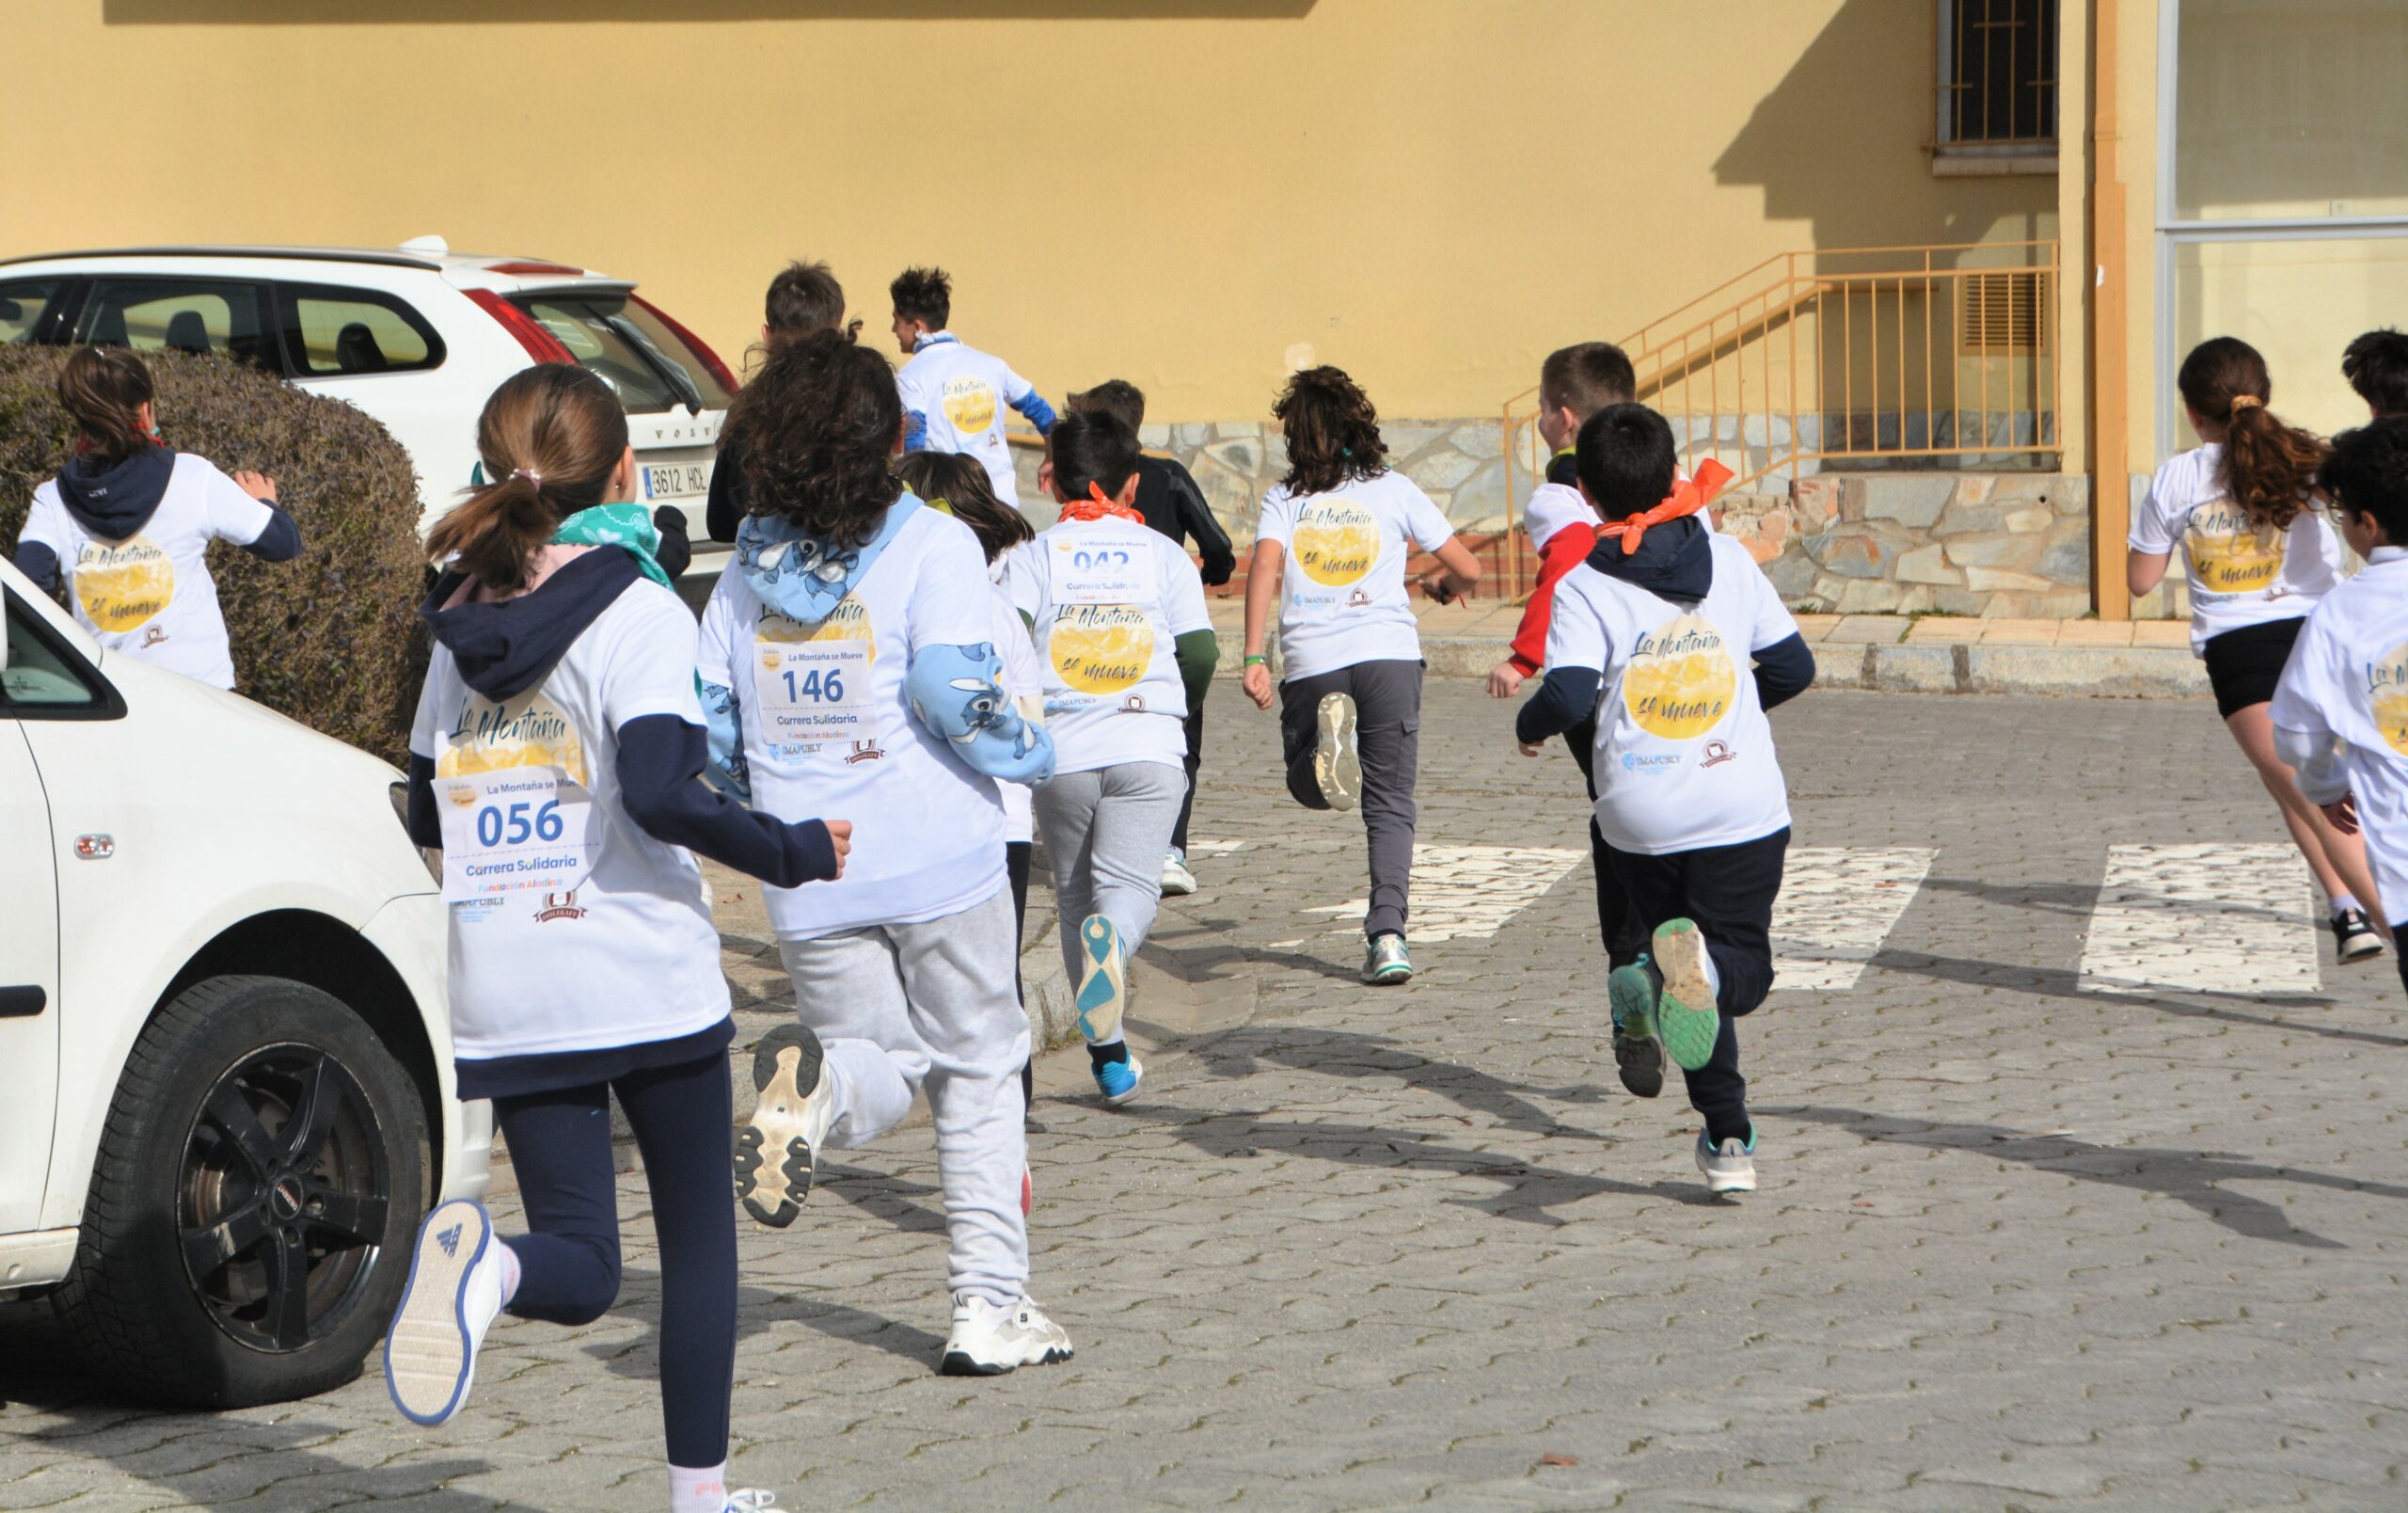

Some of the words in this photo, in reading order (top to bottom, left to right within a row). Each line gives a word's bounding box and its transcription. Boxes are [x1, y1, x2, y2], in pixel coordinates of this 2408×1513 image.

[655, 426, 711, 439] VOLV
[653, 469, 683, 494] 3612
[687, 466, 707, 490] HCL
[1296, 502, 1315, 522] La
[1317, 507, 1372, 527] Montaña
[2207, 511, 2249, 533] Mont
[1073, 550, 1130, 572] 042
[1303, 551, 1319, 565] se
[1323, 556, 1370, 574] mueve
[1101, 581, 1141, 591] Solidaa
[1054, 604, 1075, 623] La
[1078, 604, 1145, 628] Montaña
[1630, 631, 1655, 658] La
[1657, 629, 1721, 659] Montaña
[788, 654, 798, 662] La
[799, 652, 830, 661] Montaña
[840, 652, 863, 661] Mueve
[1061, 658, 1081, 671] se
[1084, 662, 1140, 681] mueve
[782, 669, 844, 703] 146
[449, 695, 475, 740] La
[477, 705, 566, 746] Montaña
[777, 715, 812, 725] Carrera
[813, 713, 858, 725] Solidaria
[1638, 696, 1657, 714] se
[1660, 700, 1723, 723] mueve
[783, 743, 823, 755] IMAPUBLY
[487, 785, 499, 795] La
[500, 780, 544, 794] Montaña
[545, 781, 555, 790] se
[477, 799, 563, 847] 056
[466, 860, 515, 877] Carrera
[516, 854, 577, 872] Solidaria
